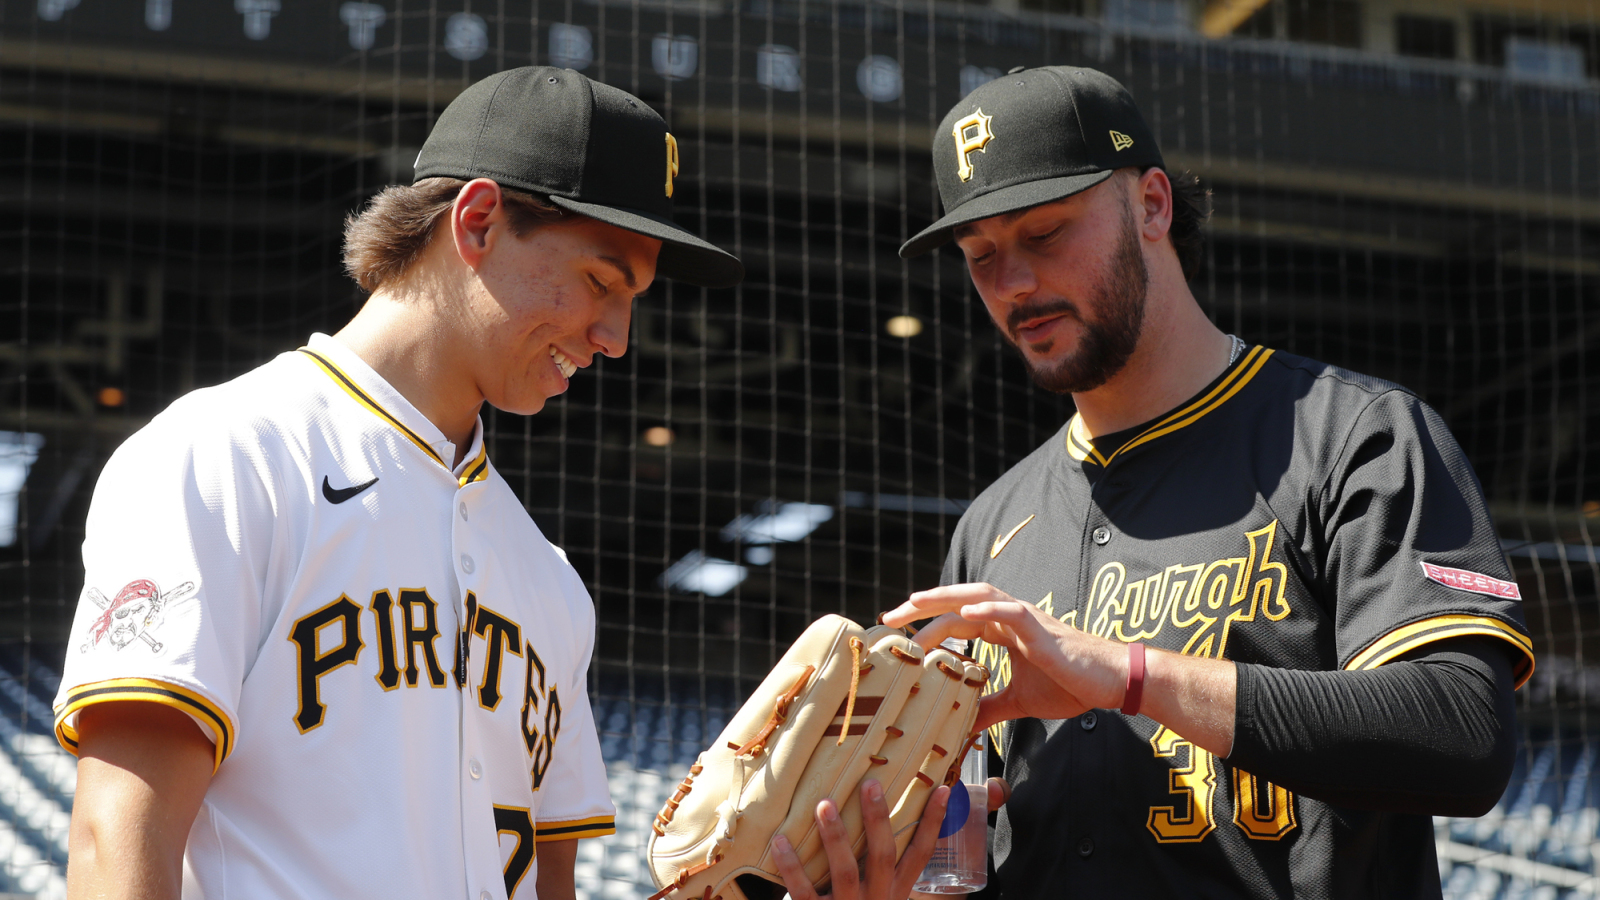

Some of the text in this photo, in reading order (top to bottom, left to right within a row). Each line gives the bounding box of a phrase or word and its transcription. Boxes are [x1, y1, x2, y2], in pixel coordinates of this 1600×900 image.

[665, 131, 679, 198] P
[952, 107, 995, 183] P
[1428, 566, 1514, 595] SHEETZ
[1145, 724, 1298, 844] 30
